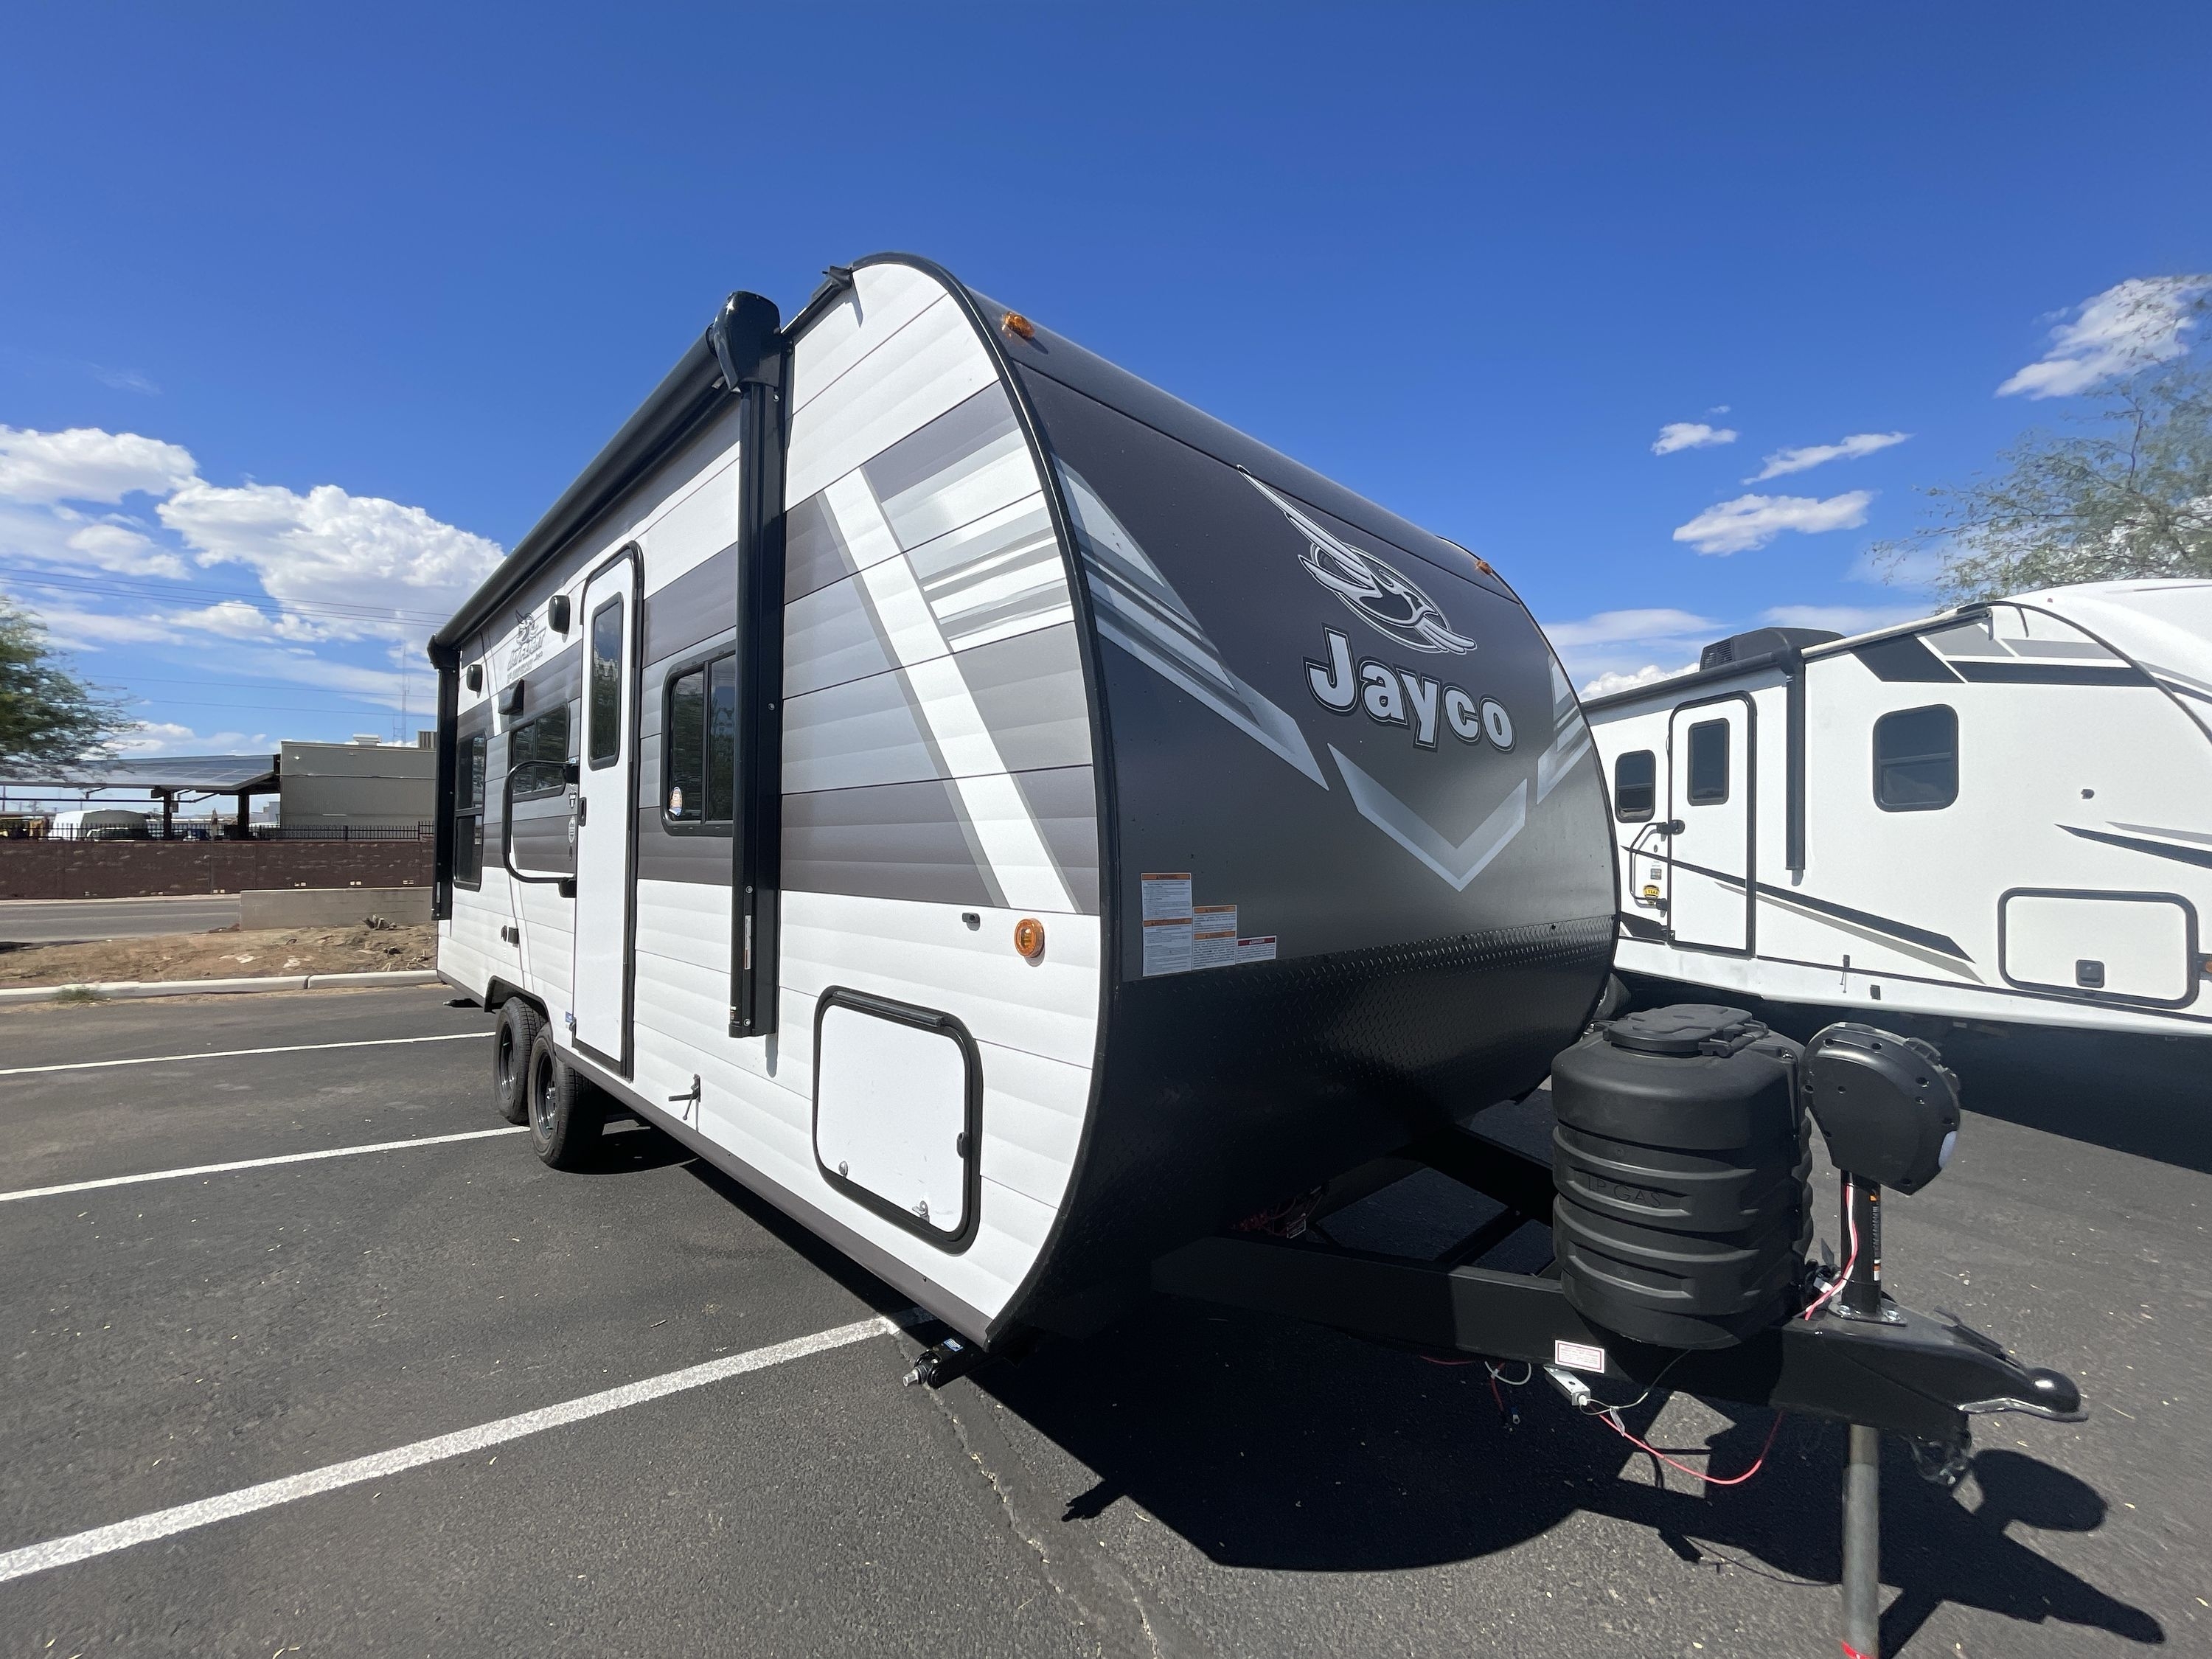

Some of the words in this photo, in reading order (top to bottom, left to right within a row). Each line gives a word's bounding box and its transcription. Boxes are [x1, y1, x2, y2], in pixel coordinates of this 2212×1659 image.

[1304, 626, 1516, 751] Jayco
[1588, 1175, 1606, 1192] LP
[1614, 1184, 1662, 1208] GAS
